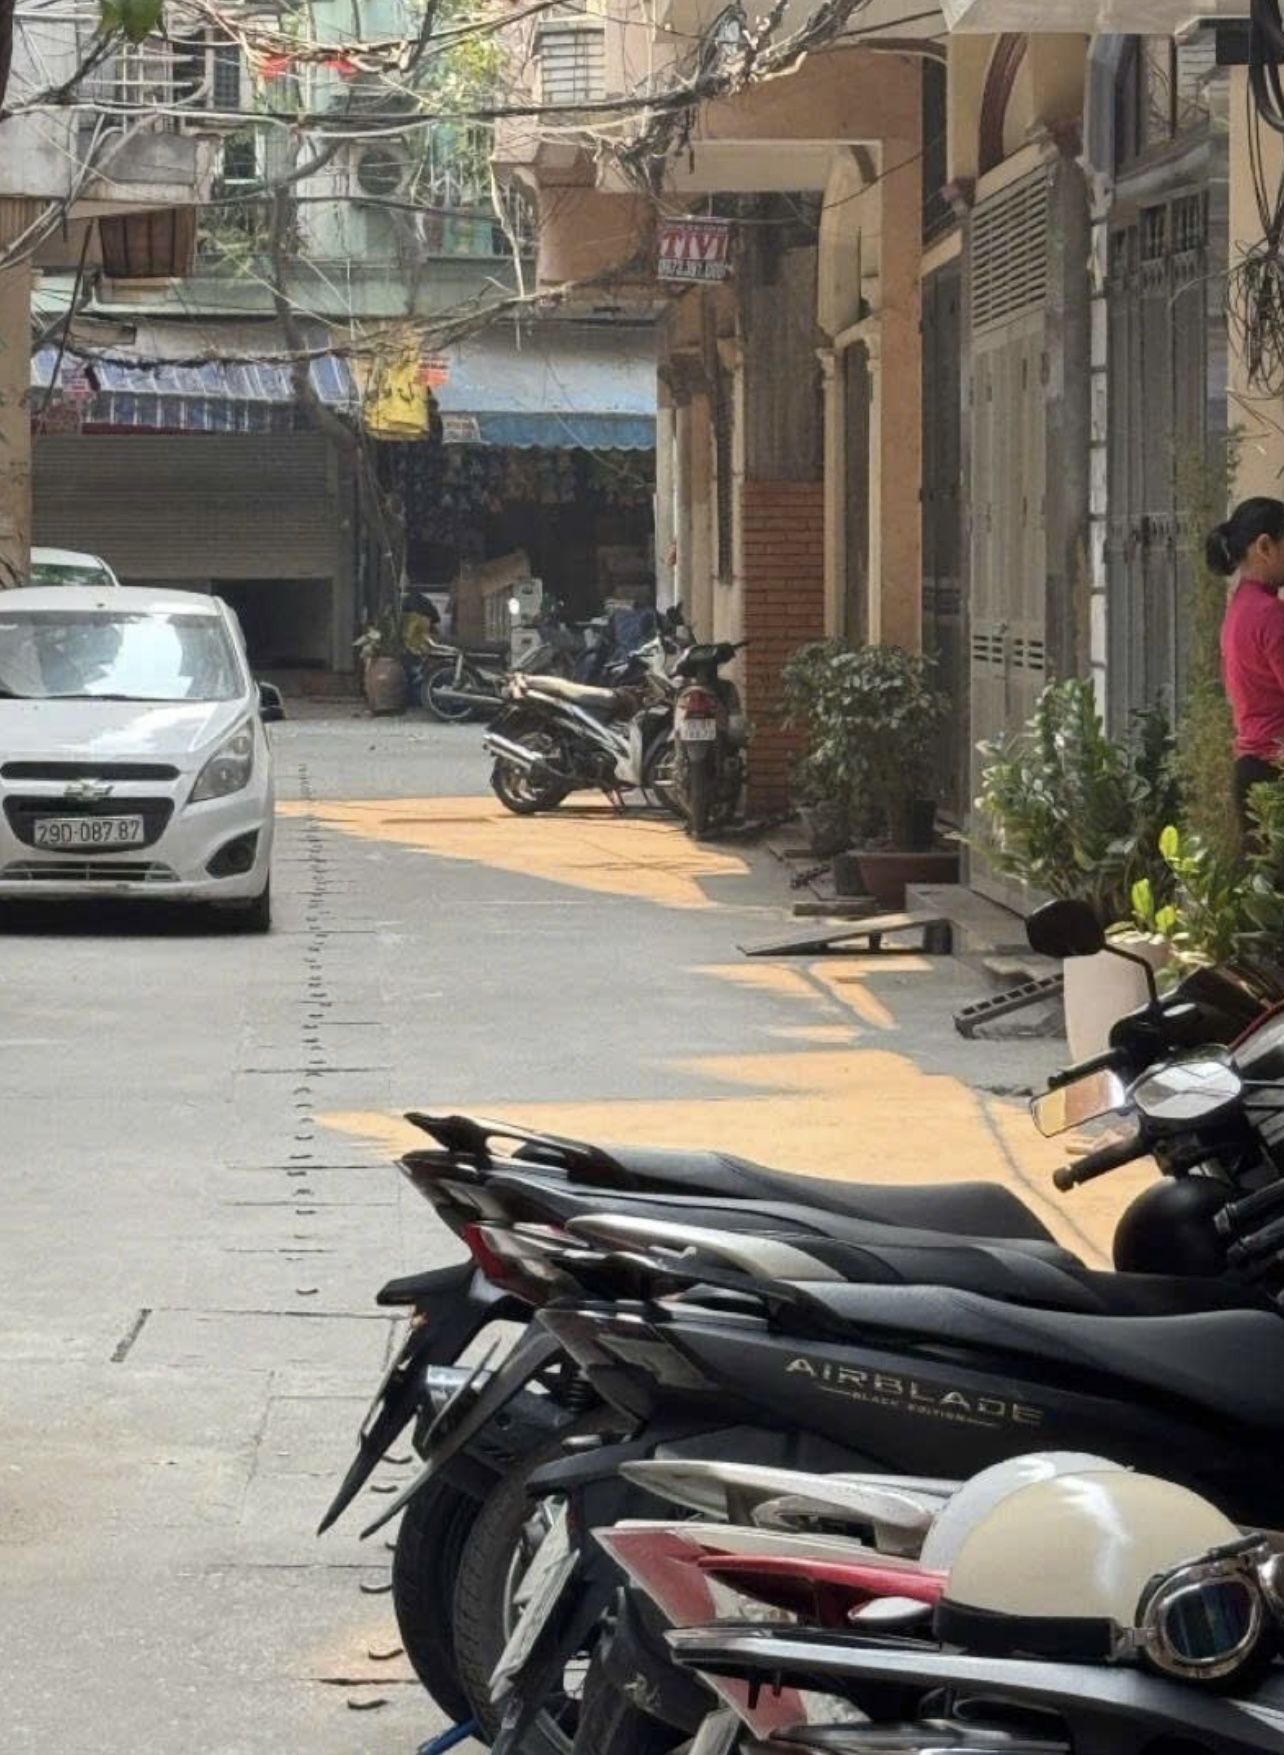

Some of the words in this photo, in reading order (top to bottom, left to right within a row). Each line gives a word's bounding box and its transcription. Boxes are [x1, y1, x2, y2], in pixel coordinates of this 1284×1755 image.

[661, 228, 727, 259] TIVI
[785, 1358, 1044, 1426] AIRBLADE
[852, 1391, 899, 1407] BLACK
